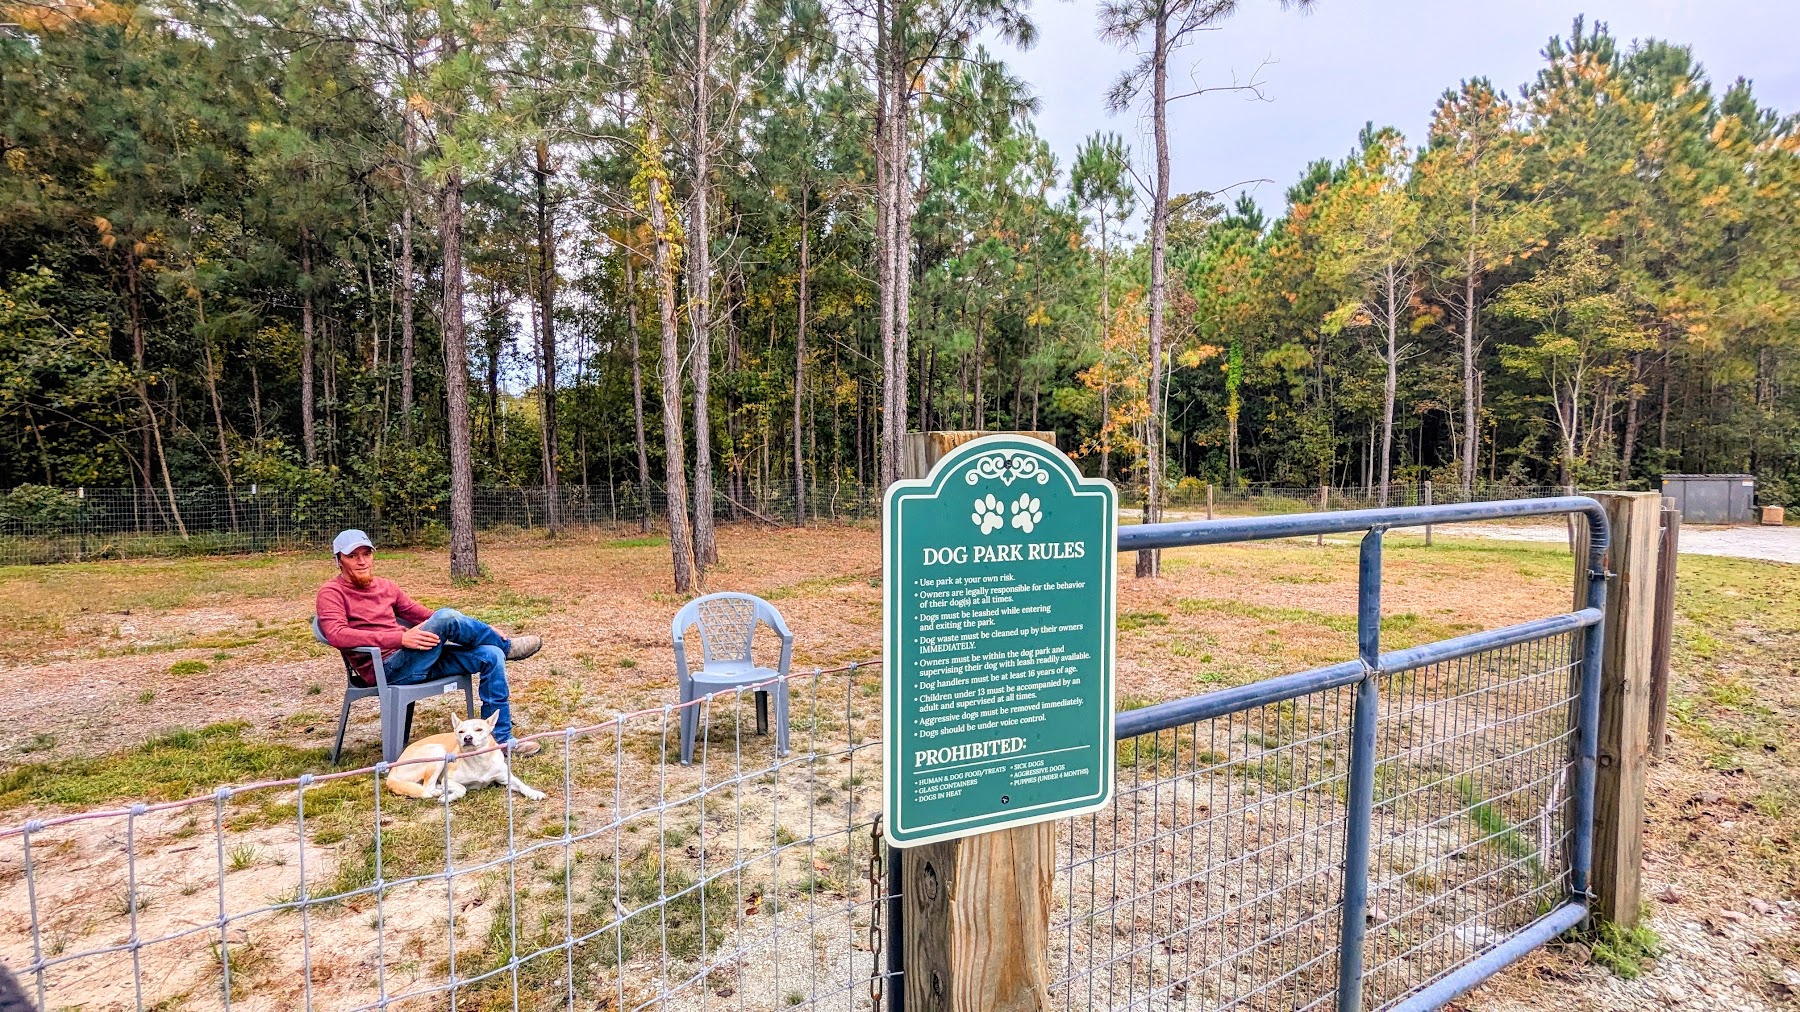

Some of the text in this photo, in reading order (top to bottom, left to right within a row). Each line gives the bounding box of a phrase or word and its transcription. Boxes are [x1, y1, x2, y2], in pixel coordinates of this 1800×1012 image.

[923, 542, 1085, 565] DOG PARK RULES
[936, 577, 953, 587] park
[964, 577, 981, 585] your
[1000, 573, 1015, 581] risk.
[966, 587, 989, 596] legally
[991, 584, 1030, 595] responsible
[1032, 583, 1042, 591] for
[1044, 582, 1055, 590] the
[1056, 581, 1085, 589] behavior
[930, 600, 947, 608] their
[950, 597, 971, 608] dog(s)
[982, 596, 990, 604] all
[992, 595, 1014, 603] times.
[920, 614, 939, 622] Dogs
[972, 608, 999, 617] leashed
[1001, 607, 1020, 615] while
[1022, 605, 1051, 613] entering
[920, 618, 995, 631] and exiting the park.
[920, 637, 935, 645] Dog
[991, 628, 1018, 637] cleaned
[1021, 629, 1029, 637] up
[1031, 627, 1039, 636] by
[1041, 625, 1057, 633] their
[920, 642, 976, 654] IMMEDIATELY.
[920, 658, 949, 667] Owners
[982, 652, 1005, 660] within
[1007, 650, 1019, 658] the
[1021, 649, 1033, 657] dog
[1035, 647, 1050, 657] park
[1052, 645, 1064, 653] and
[920, 652, 1091, 678] supervising their dog with leash readily available.
[920, 682, 935, 690] Dog
[937, 678, 969, 688] handlers
[1010, 671, 1026, 679] least
[1037, 668, 1055, 678] years
[1056, 666, 1063, 674] of
[1065, 666, 1078, 674] age.
[920, 693, 952, 702] Children
[954, 690, 976, 698] under
[1017, 679, 1060, 691] accompanied
[1063, 678, 1071, 687] by
[919, 704, 939, 712] adult
[941, 701, 954, 710] and
[956, 696, 995, 709] supervised
[1016, 692, 1037, 700] times.
[919, 714, 960, 726] Aggressive
[962, 711, 979, 720] dogs
[1010, 702, 1040, 713] removed
[1042, 697, 1084, 709] immediately.
[920, 714, 1046, 738] Dogs should be under voice control.
[915, 736, 1027, 767] PROHIBITED:
[1014, 760, 1044, 770] SICK DOGS
[1014, 764, 1066, 778] AGGRESSIVE DOGS
[919, 776, 943, 785] HUMAN
[965, 766, 1006, 777] FOOD/TREATS
[1014, 777, 1036, 786] PUPPIES
[1038, 773, 1058, 783] (UNDER
[1063, 768, 1089, 778] MONTHS)
[919, 779, 978, 794] GLASS CONTAINERS
[919, 794, 936, 802] DOGS
